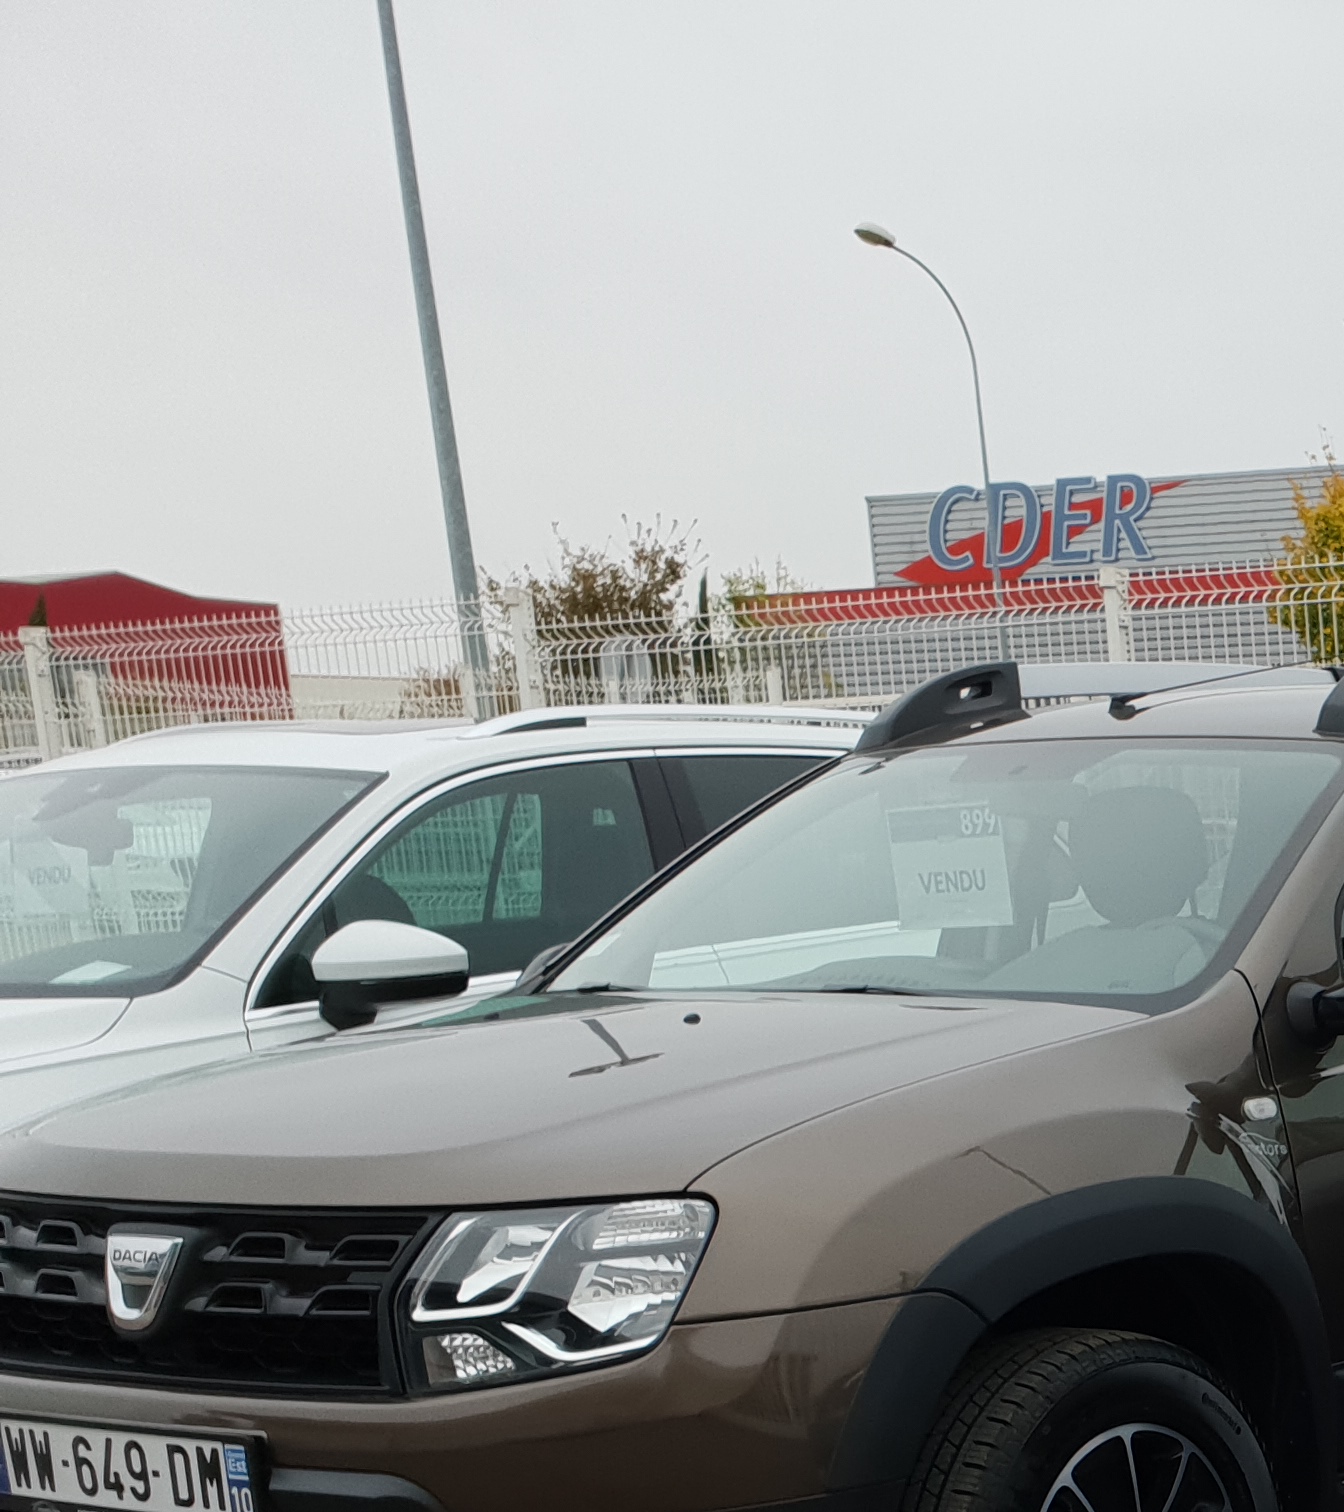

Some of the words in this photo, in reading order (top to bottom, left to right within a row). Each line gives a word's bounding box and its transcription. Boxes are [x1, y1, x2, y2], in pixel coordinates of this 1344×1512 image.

[927, 473, 1154, 571] CDER
[917, 868, 986, 894] VENDU
[112, 1248, 160, 1264] DACIA
[4, 1425, 227, 1512] WW-649-DM
